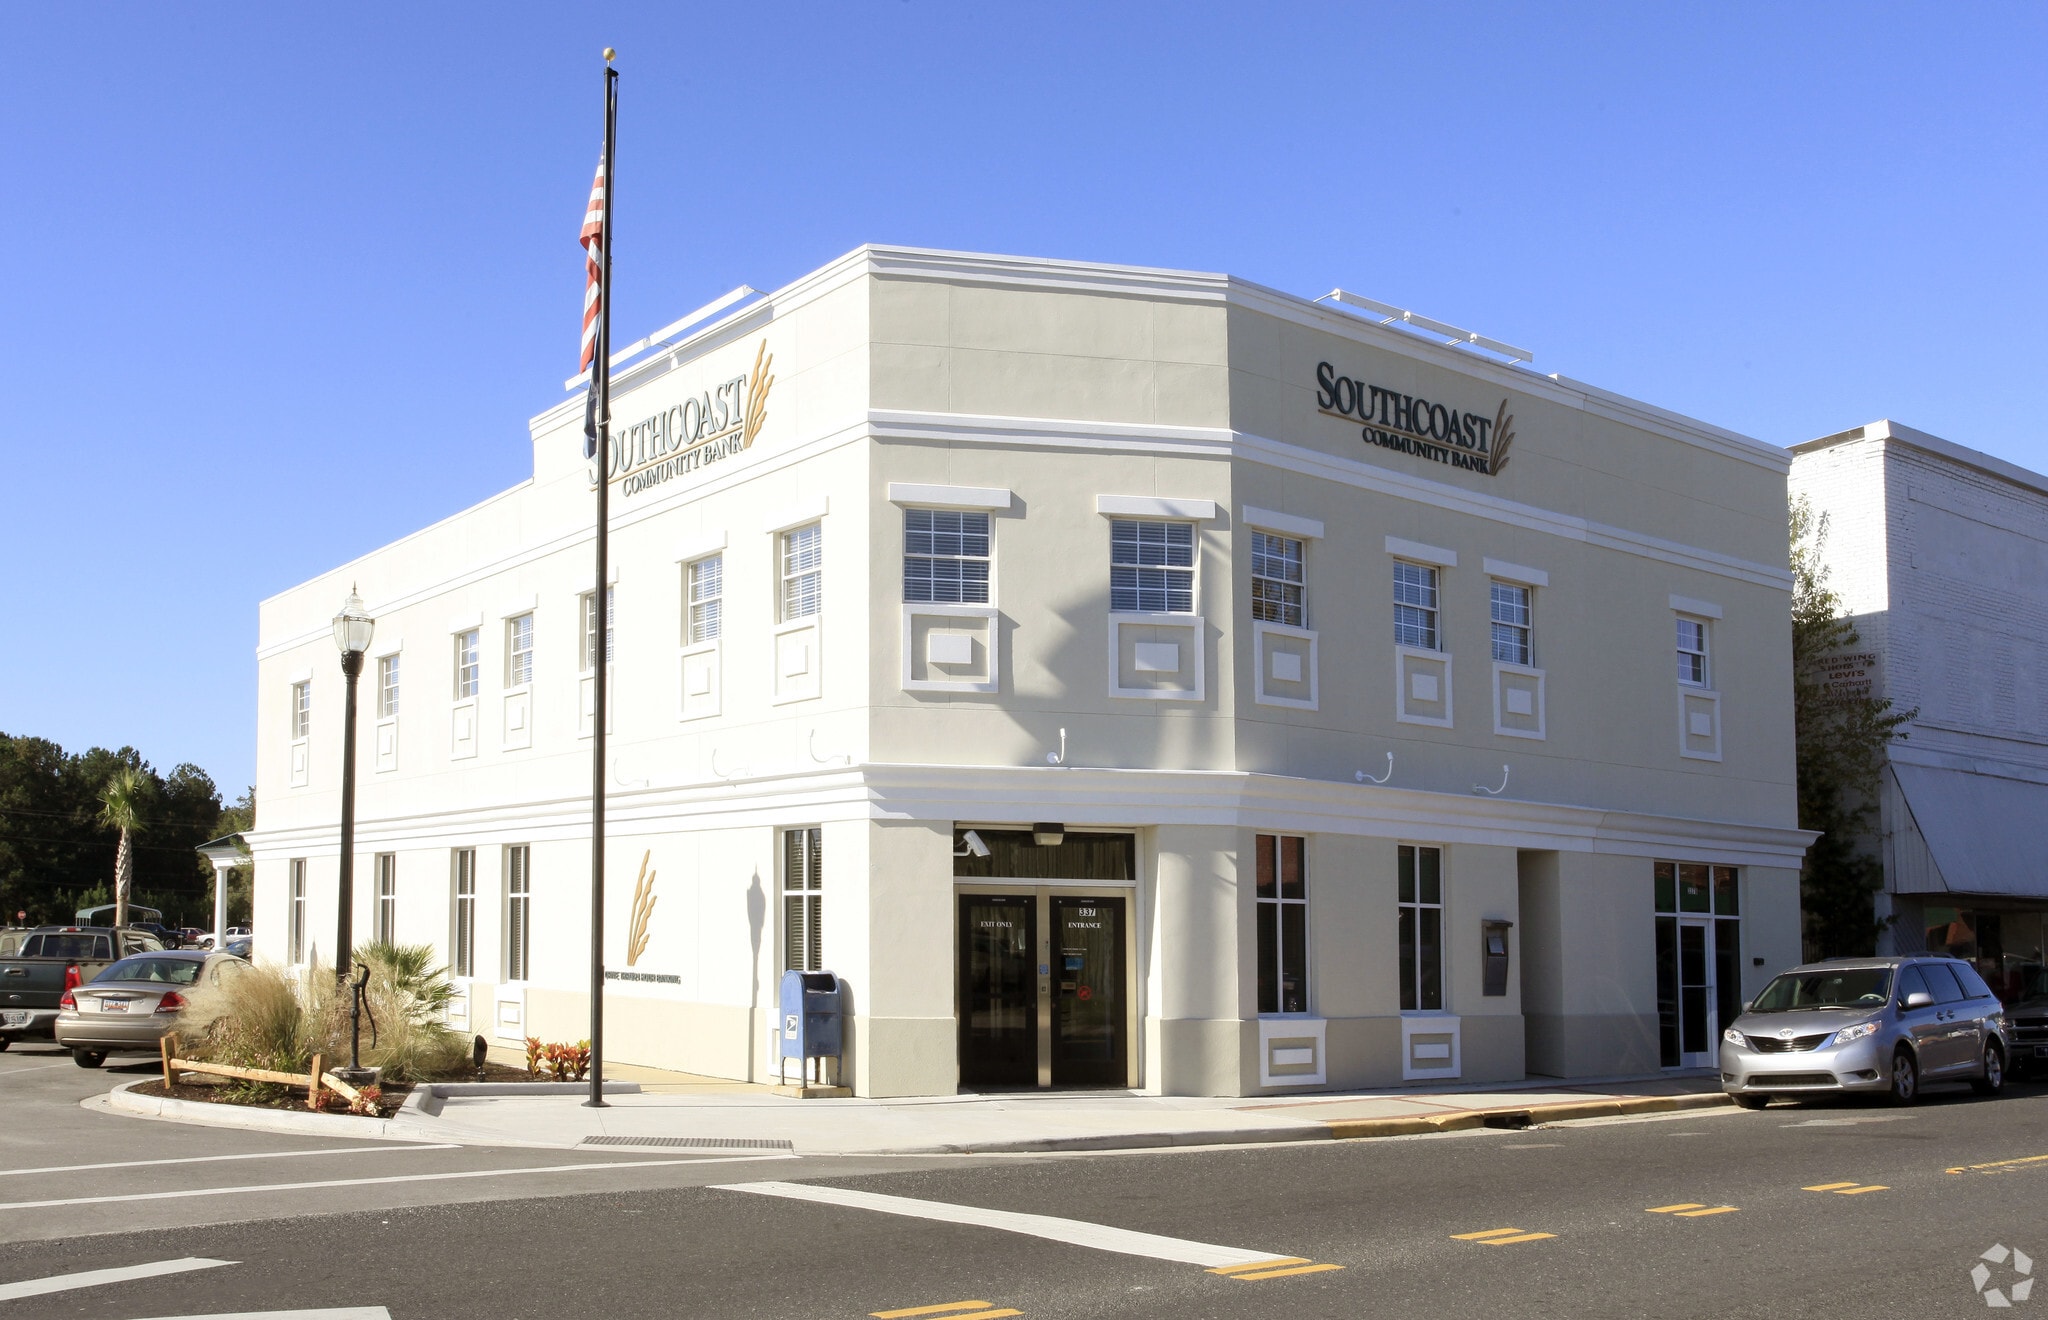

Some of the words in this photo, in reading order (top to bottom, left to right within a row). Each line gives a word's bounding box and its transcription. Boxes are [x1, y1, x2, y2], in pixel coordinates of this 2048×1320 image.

[1316, 361, 1492, 453] SOUTHCOAST
[622, 449, 701, 498] COMMUNITY
[703, 431, 744, 467] BANK
[1362, 427, 1449, 465] COMMUNITY
[1452, 452, 1490, 475] BANK
[1079, 907, 1096, 917] 337
